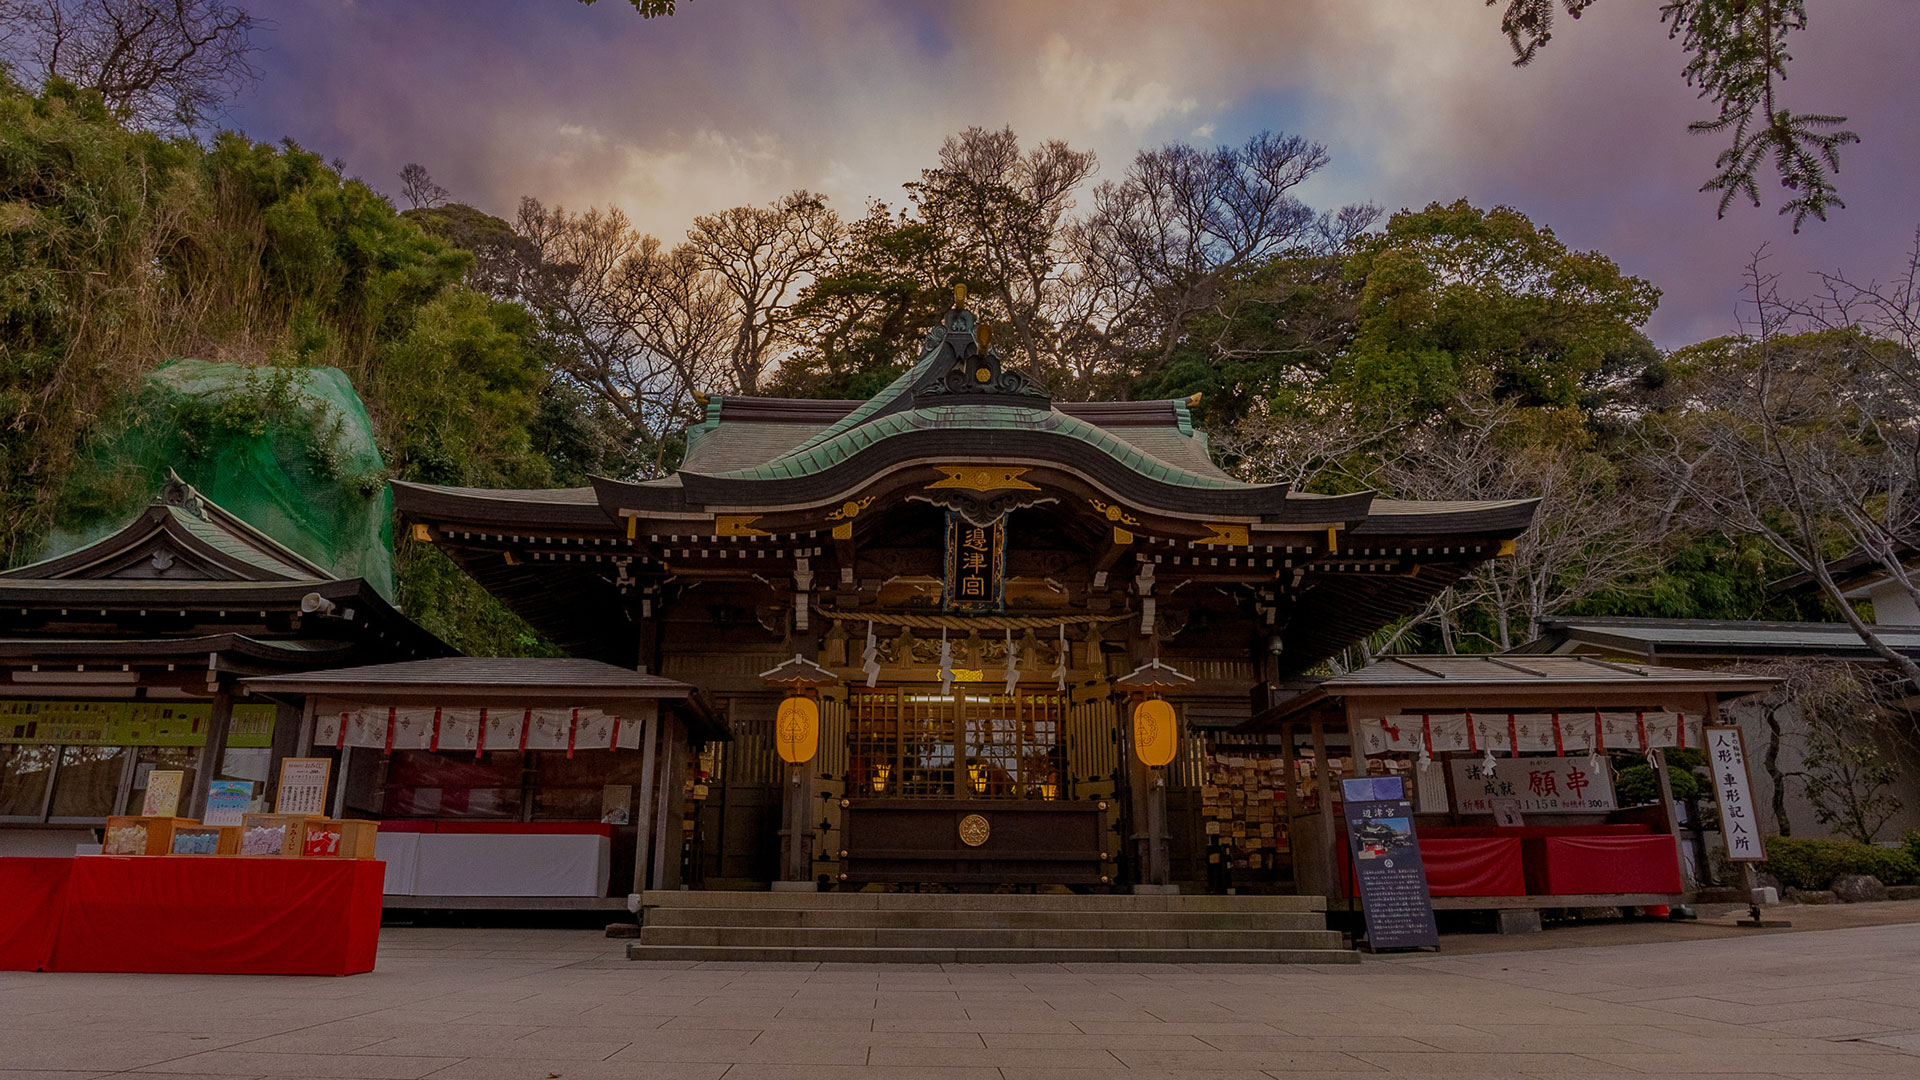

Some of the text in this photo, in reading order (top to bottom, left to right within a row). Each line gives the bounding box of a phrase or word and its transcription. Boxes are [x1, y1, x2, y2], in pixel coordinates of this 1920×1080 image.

[1465, 764, 1498, 780] 諸
[1528, 766, 1590, 799] 願串
[1484, 780, 1516, 796] 成就
[1716, 735, 1749, 851] 人形・車形記入所
